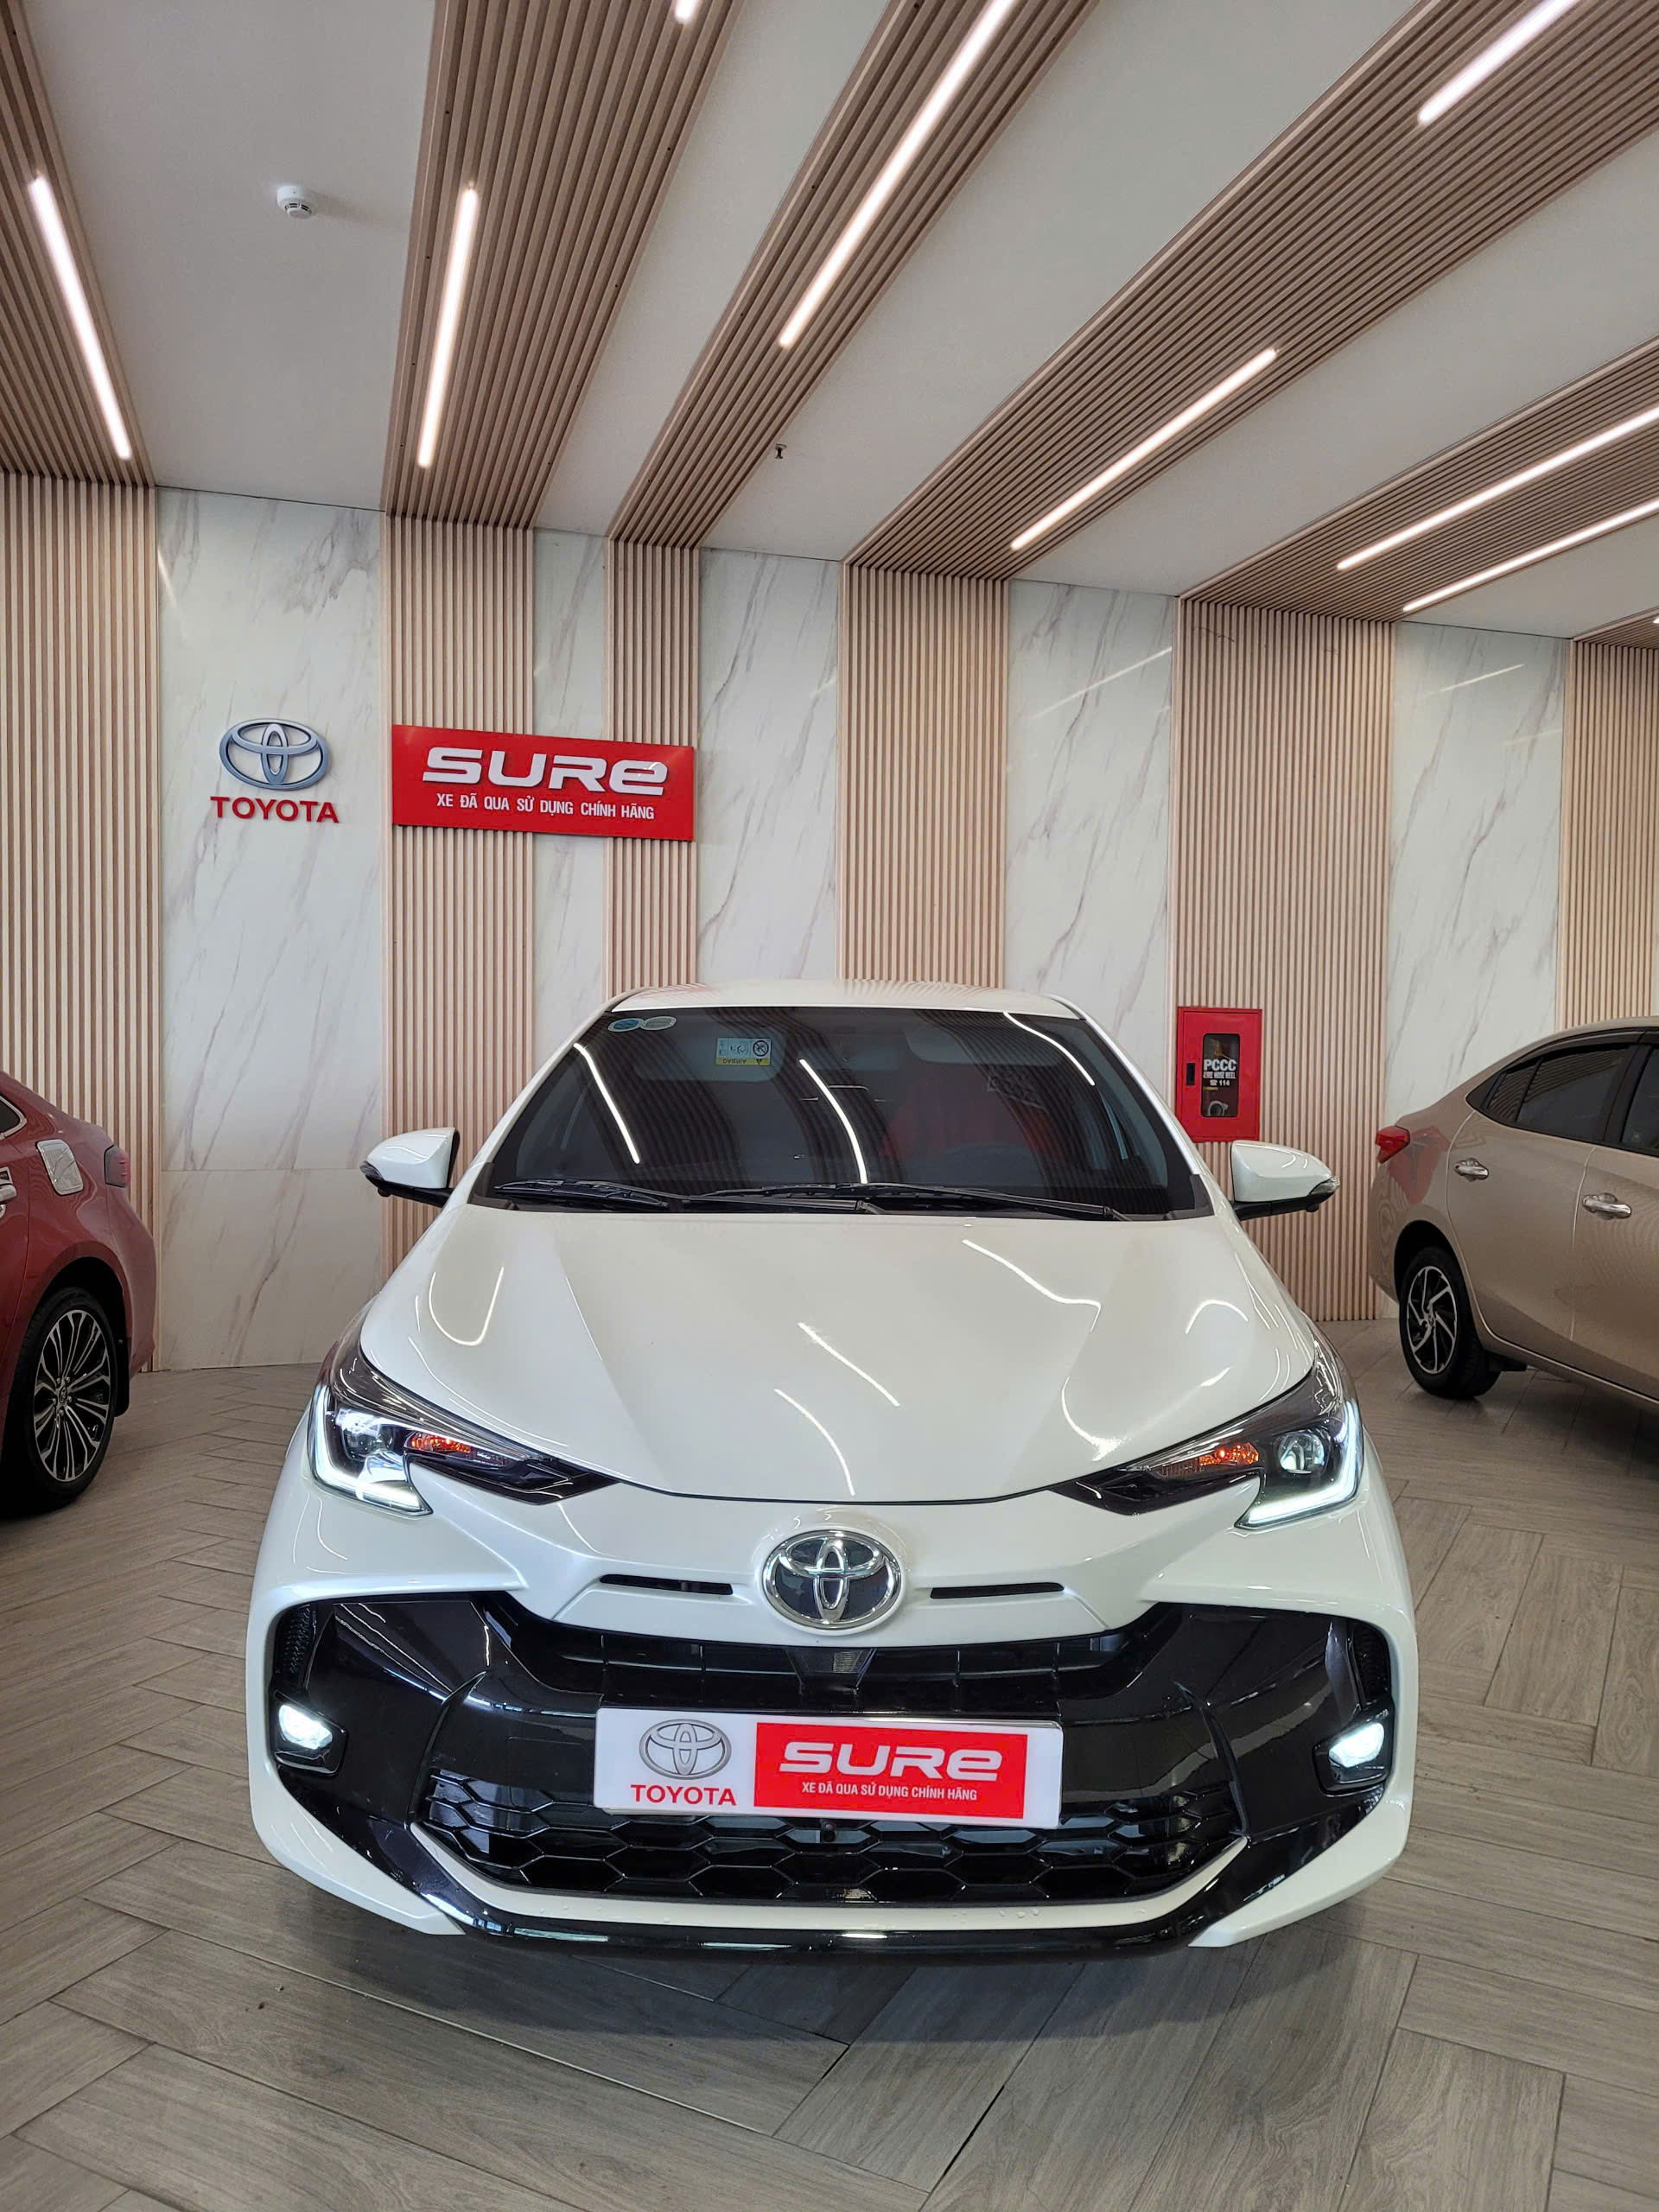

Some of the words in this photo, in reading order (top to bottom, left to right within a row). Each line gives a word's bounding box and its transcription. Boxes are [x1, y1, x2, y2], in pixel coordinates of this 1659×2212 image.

[210, 796, 340, 823] TOYOTA
[436, 792, 454, 808] XE
[460, 792, 478, 809] ĐÃ
[484, 795, 510, 811] QUA
[516, 795, 535, 813] SỬ
[540, 799, 574, 817] DỤNG
[581, 800, 616, 818] CHÍNH
[621, 803, 655, 820] HÃNG
[1204, 1058, 1236, 1071] PCCC
[631, 1783, 736, 1807] TOYOTA
[802, 1782, 816, 1794] XE
[817, 1781, 833, 1795] ĐÃ
[836, 1783, 858, 1796] QUA
[861, 1781, 877, 1796] SỬ
[879, 1785, 909, 1800] DỤNG
[912, 1785, 944, 1800] CHÍNH
[947, 1786, 977, 1801] HÃNG
